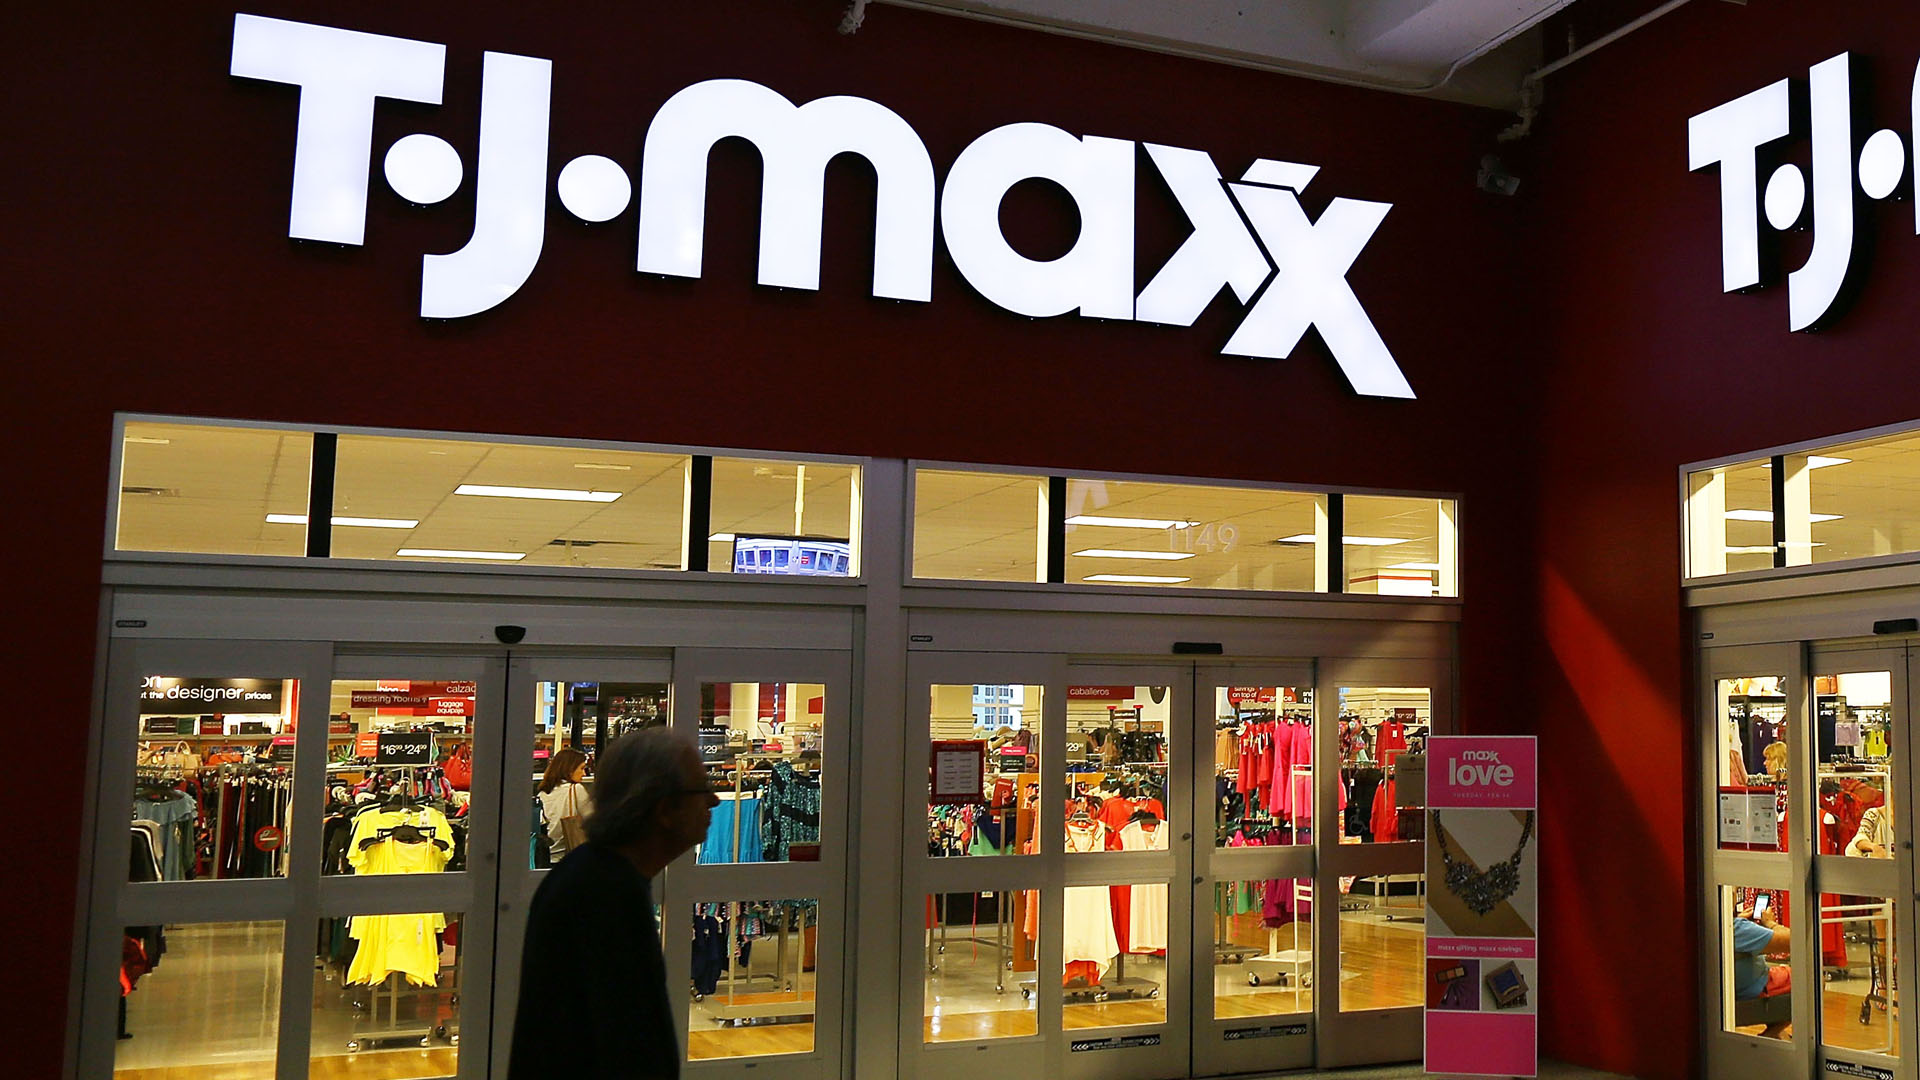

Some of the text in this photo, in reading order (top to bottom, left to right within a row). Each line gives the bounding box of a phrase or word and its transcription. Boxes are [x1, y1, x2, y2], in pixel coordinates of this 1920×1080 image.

[1166, 523, 1240, 553] 1149
[149, 691, 165, 699] the
[167, 685, 244, 702] designer
[245, 692, 272, 700] prices
[1070, 687, 1110, 696] caballeros
[353, 693, 420, 704] dressing rooms
[438, 700, 464, 708] luggage
[437, 707, 465, 715] equipaje
[1463, 751, 1501, 764] maxx
[1449, 758, 1514, 787] love
